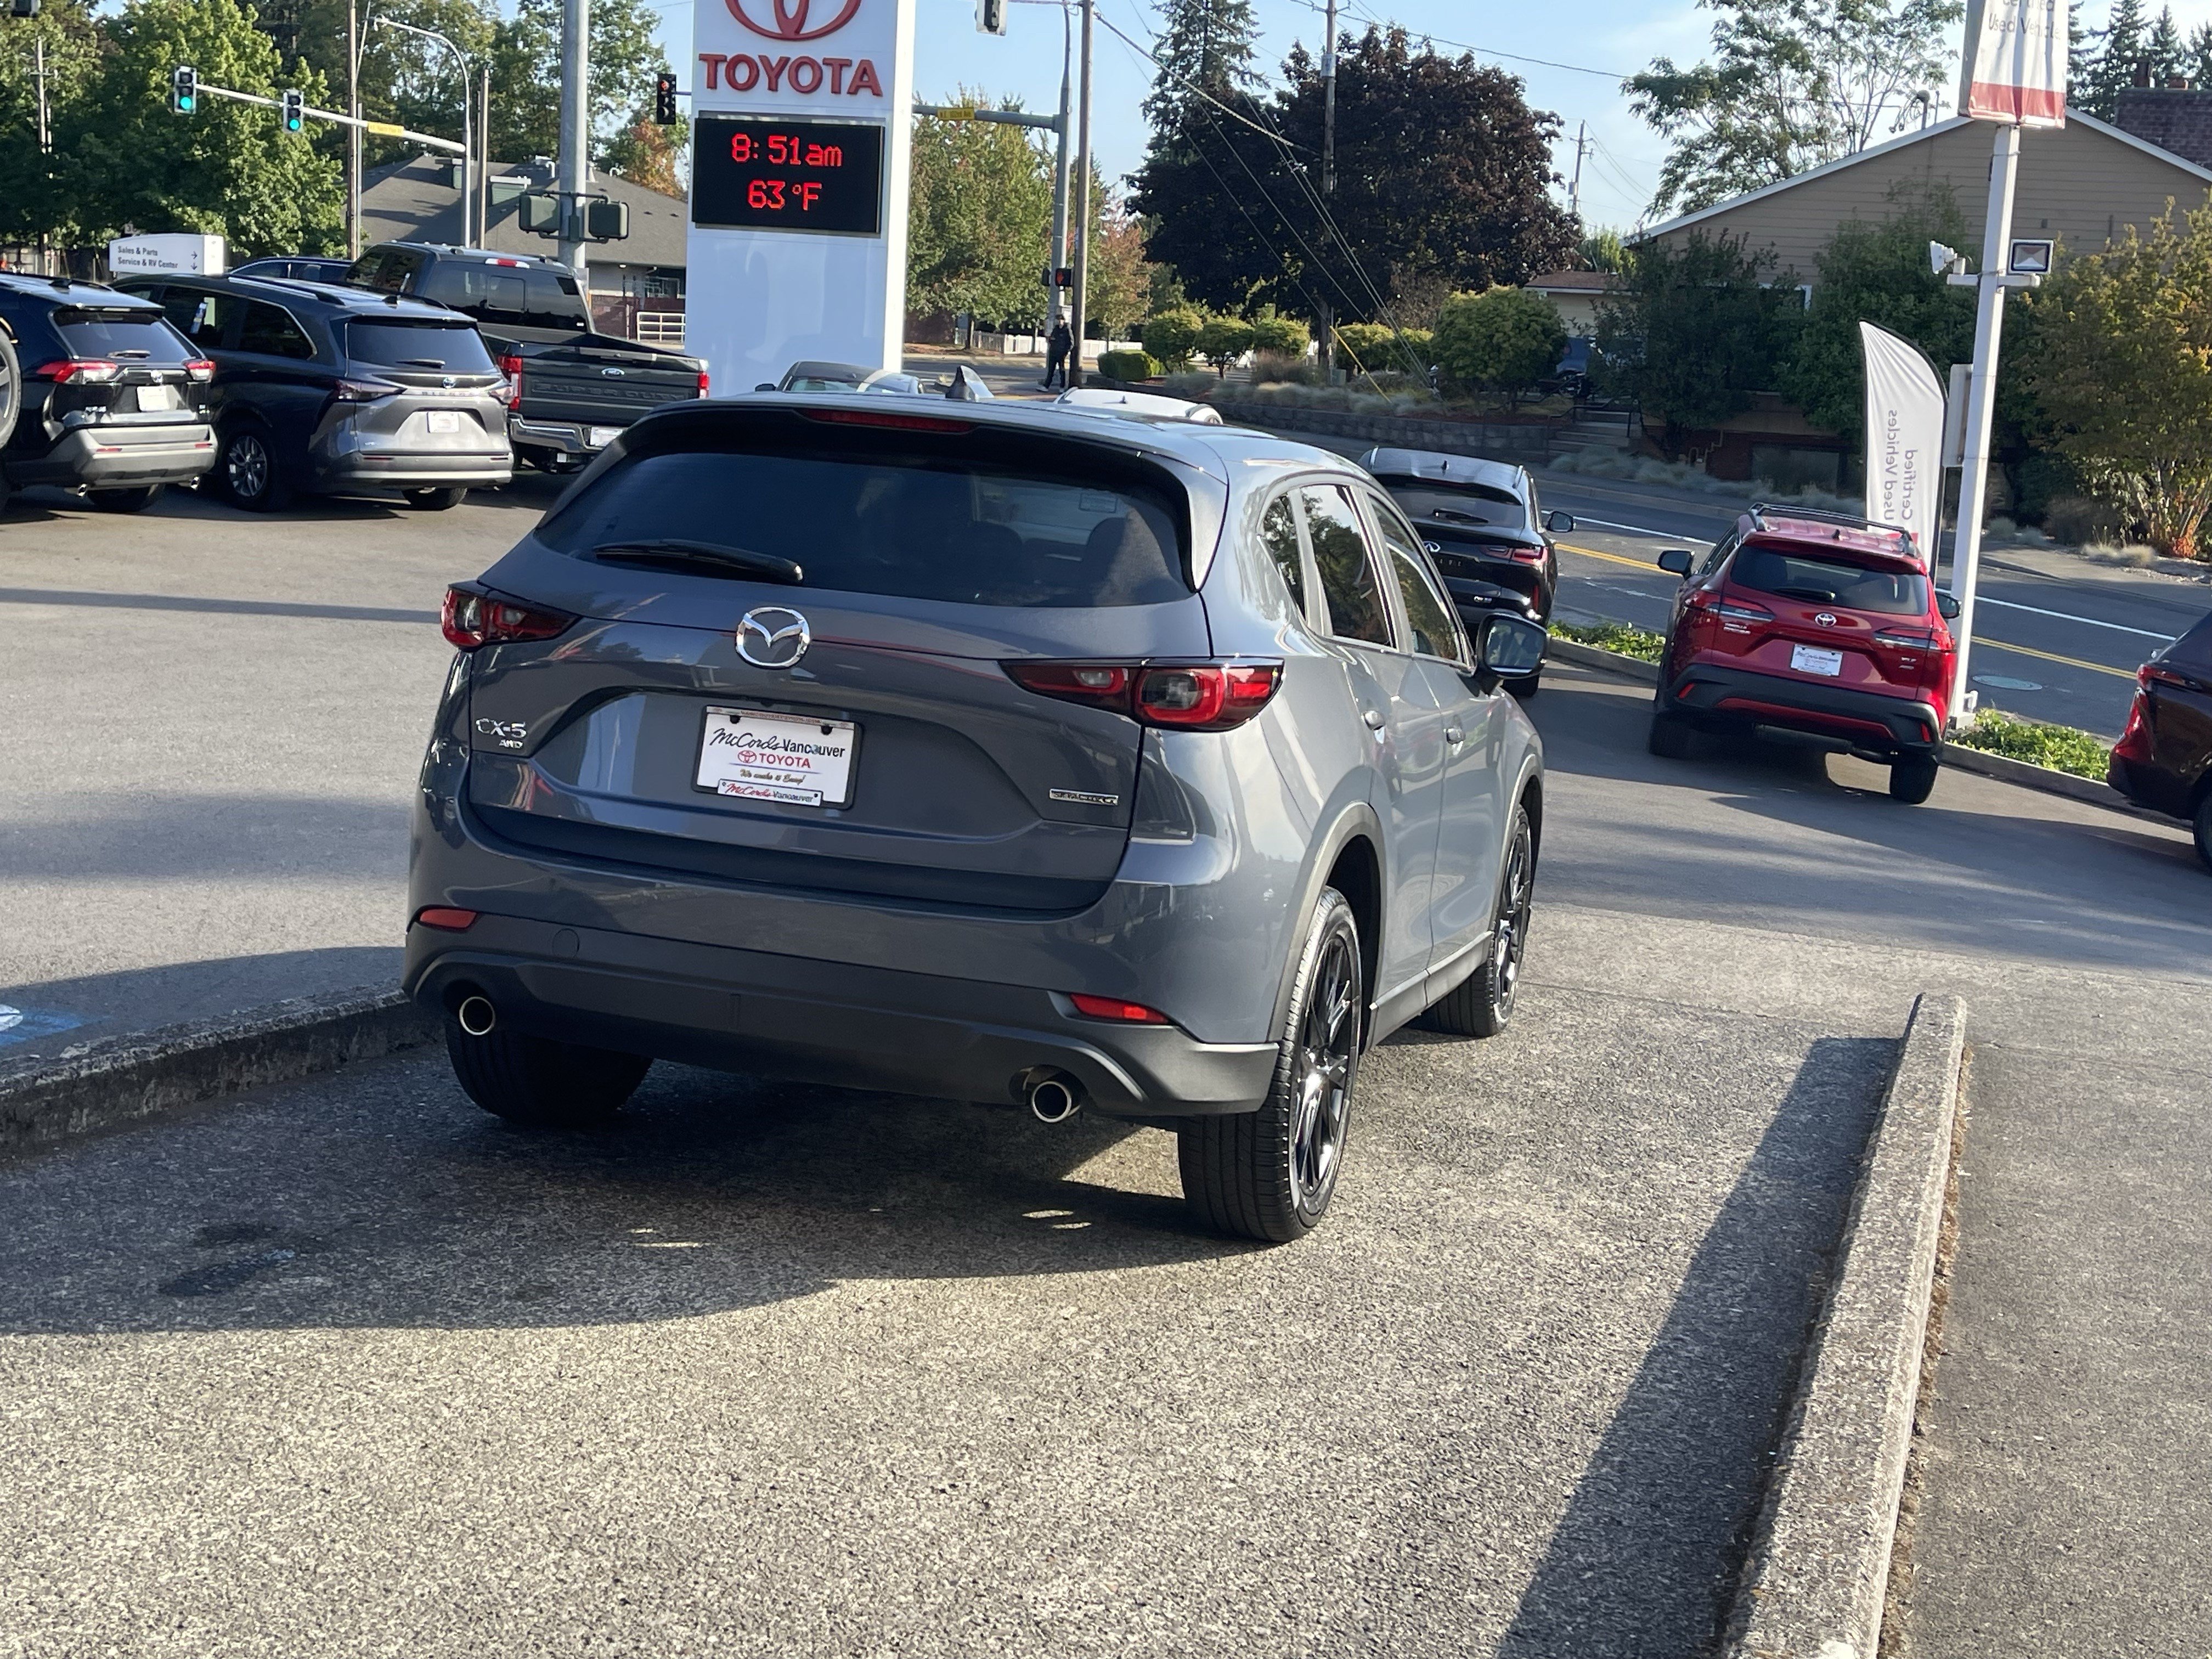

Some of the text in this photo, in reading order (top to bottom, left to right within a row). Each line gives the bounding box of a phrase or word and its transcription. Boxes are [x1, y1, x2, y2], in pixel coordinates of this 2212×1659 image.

[1989, 13, 2016, 32] Used
[698, 53, 883, 97] TOYOTA
[731, 133, 843, 167] 8:51am
[117, 246, 134, 255] Sales
[143, 247, 158, 256] Parts
[117, 257, 140, 266] Service
[148, 259, 156, 267] RV
[158, 260, 178, 269] Center
[475, 718, 527, 738] CX-5
[759, 753, 811, 769] TOYOTA
